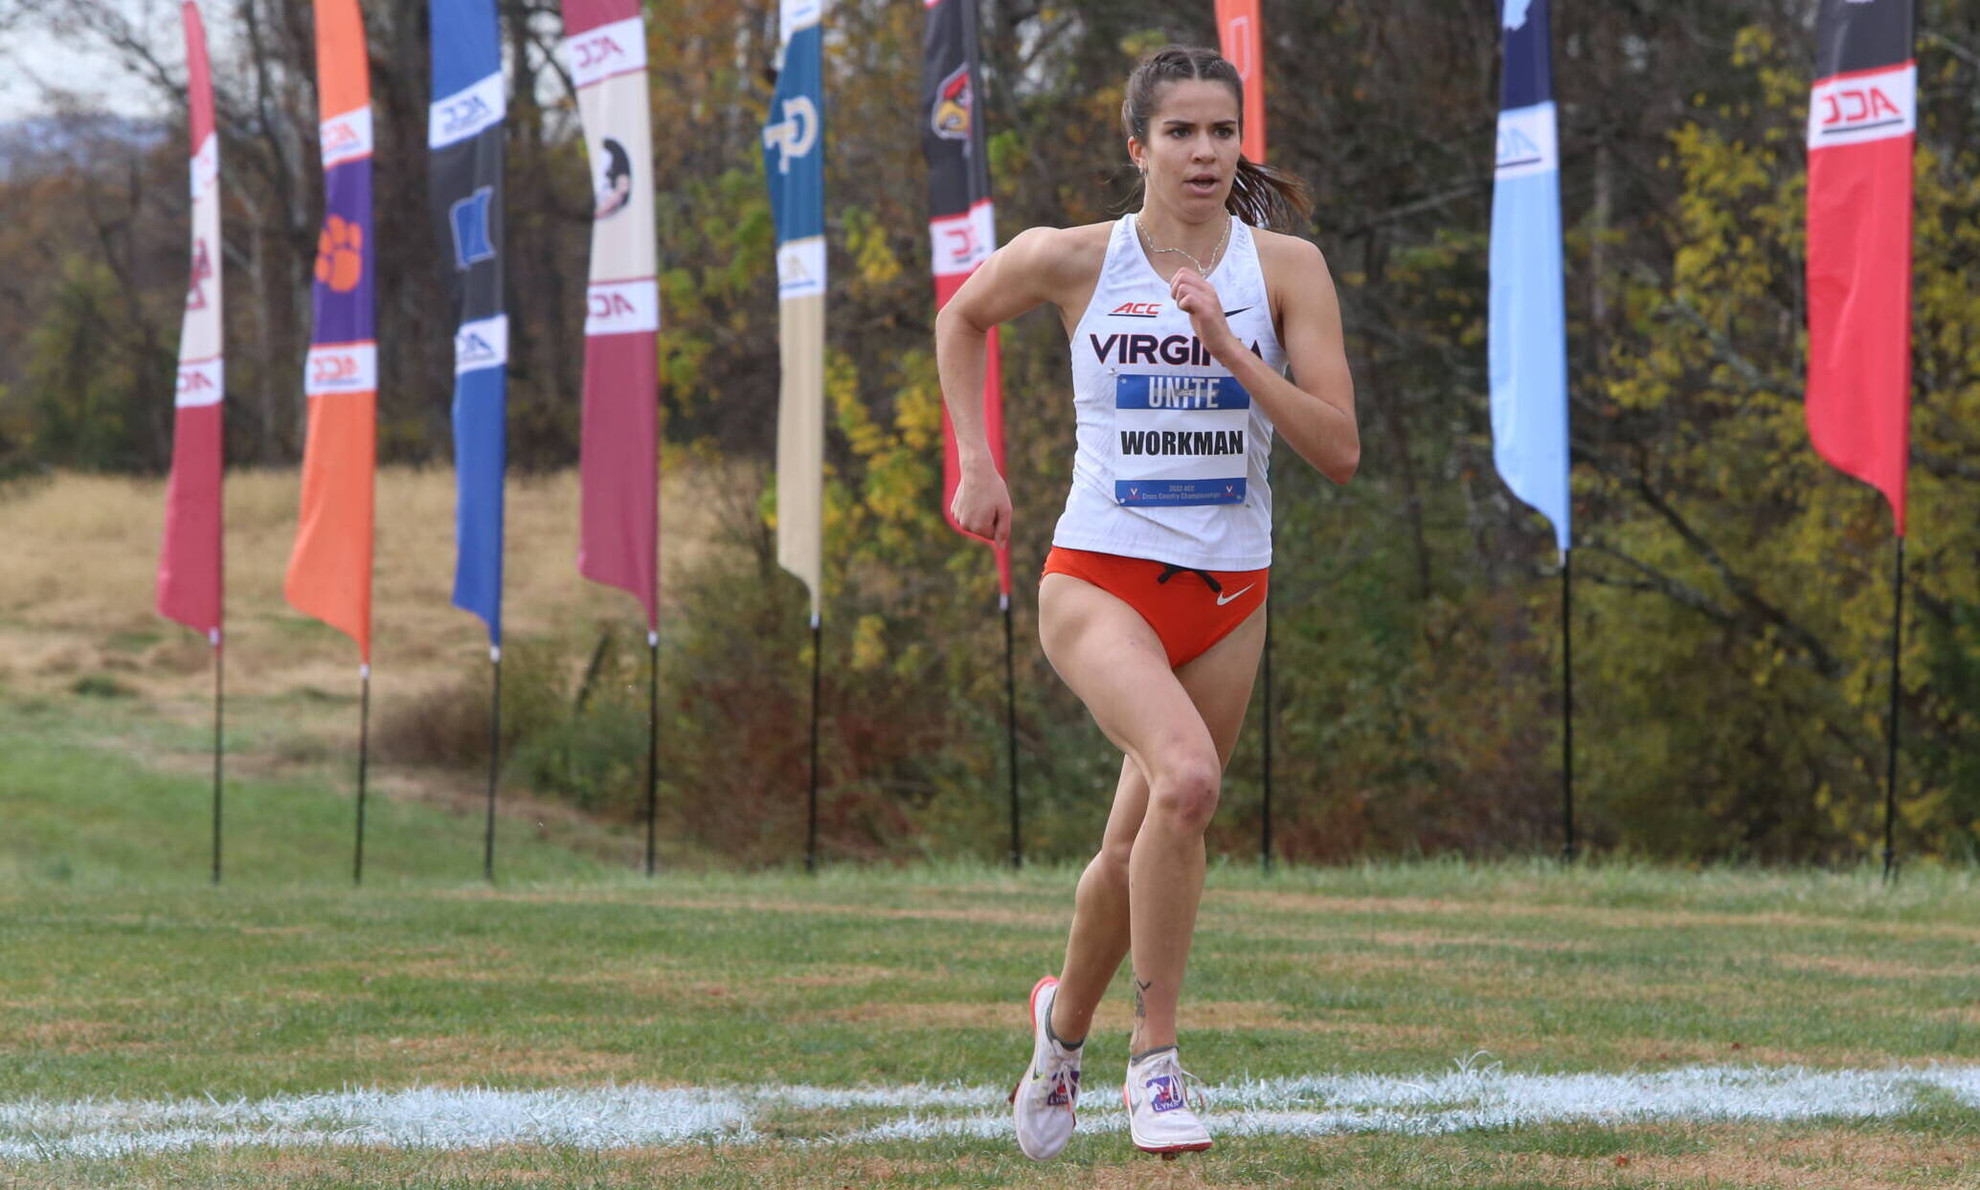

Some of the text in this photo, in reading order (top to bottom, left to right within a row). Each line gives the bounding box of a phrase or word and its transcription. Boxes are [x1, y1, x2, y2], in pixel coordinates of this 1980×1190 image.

[1112, 302, 1162, 315] ACC
[1090, 333, 1263, 366] VIRGIA
[1149, 376, 1220, 408] UNITE
[1120, 430, 1244, 455] WORKMAN
